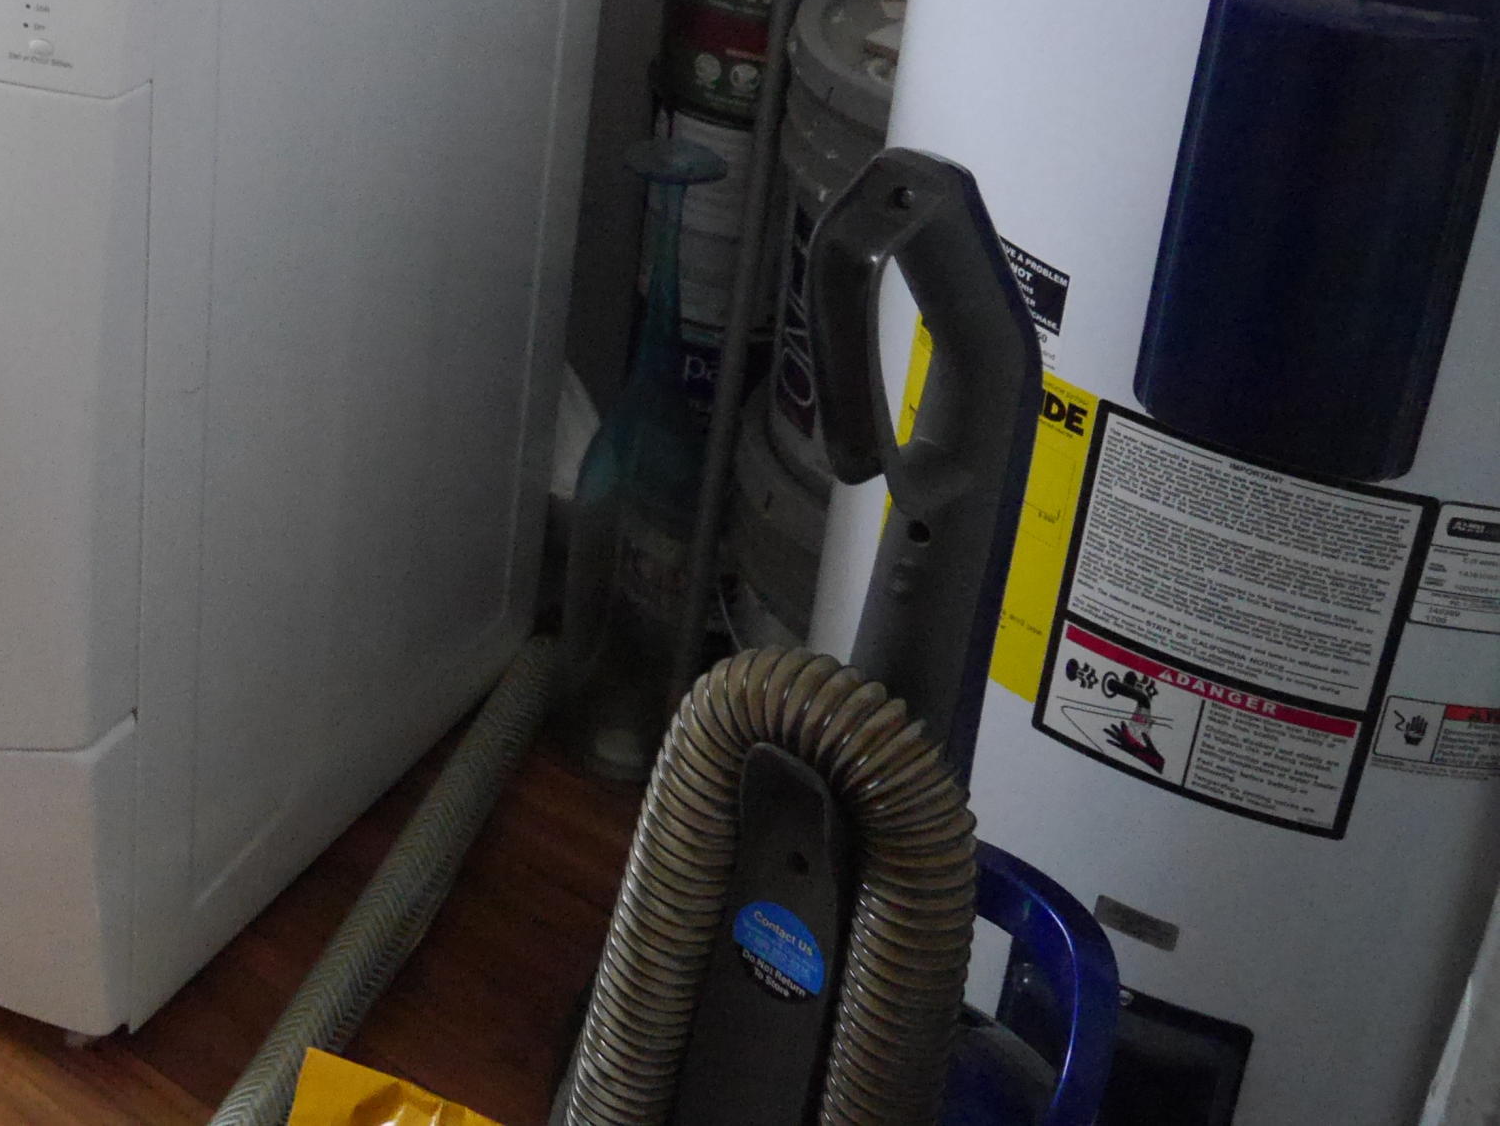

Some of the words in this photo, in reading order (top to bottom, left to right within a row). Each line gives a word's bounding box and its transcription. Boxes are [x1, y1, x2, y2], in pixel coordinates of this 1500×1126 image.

[1025, 258, 1068, 287] PROBLEM
[1230, 462, 1284, 484] IMPORTANT
[1177, 674, 1277, 715] DANGER
[754, 911, 797, 947] Contact
[798, 940, 814, 956] Us
[742, 949, 755, 963] Do
[775, 971, 806, 997] Return
[765, 976, 790, 997] Store
